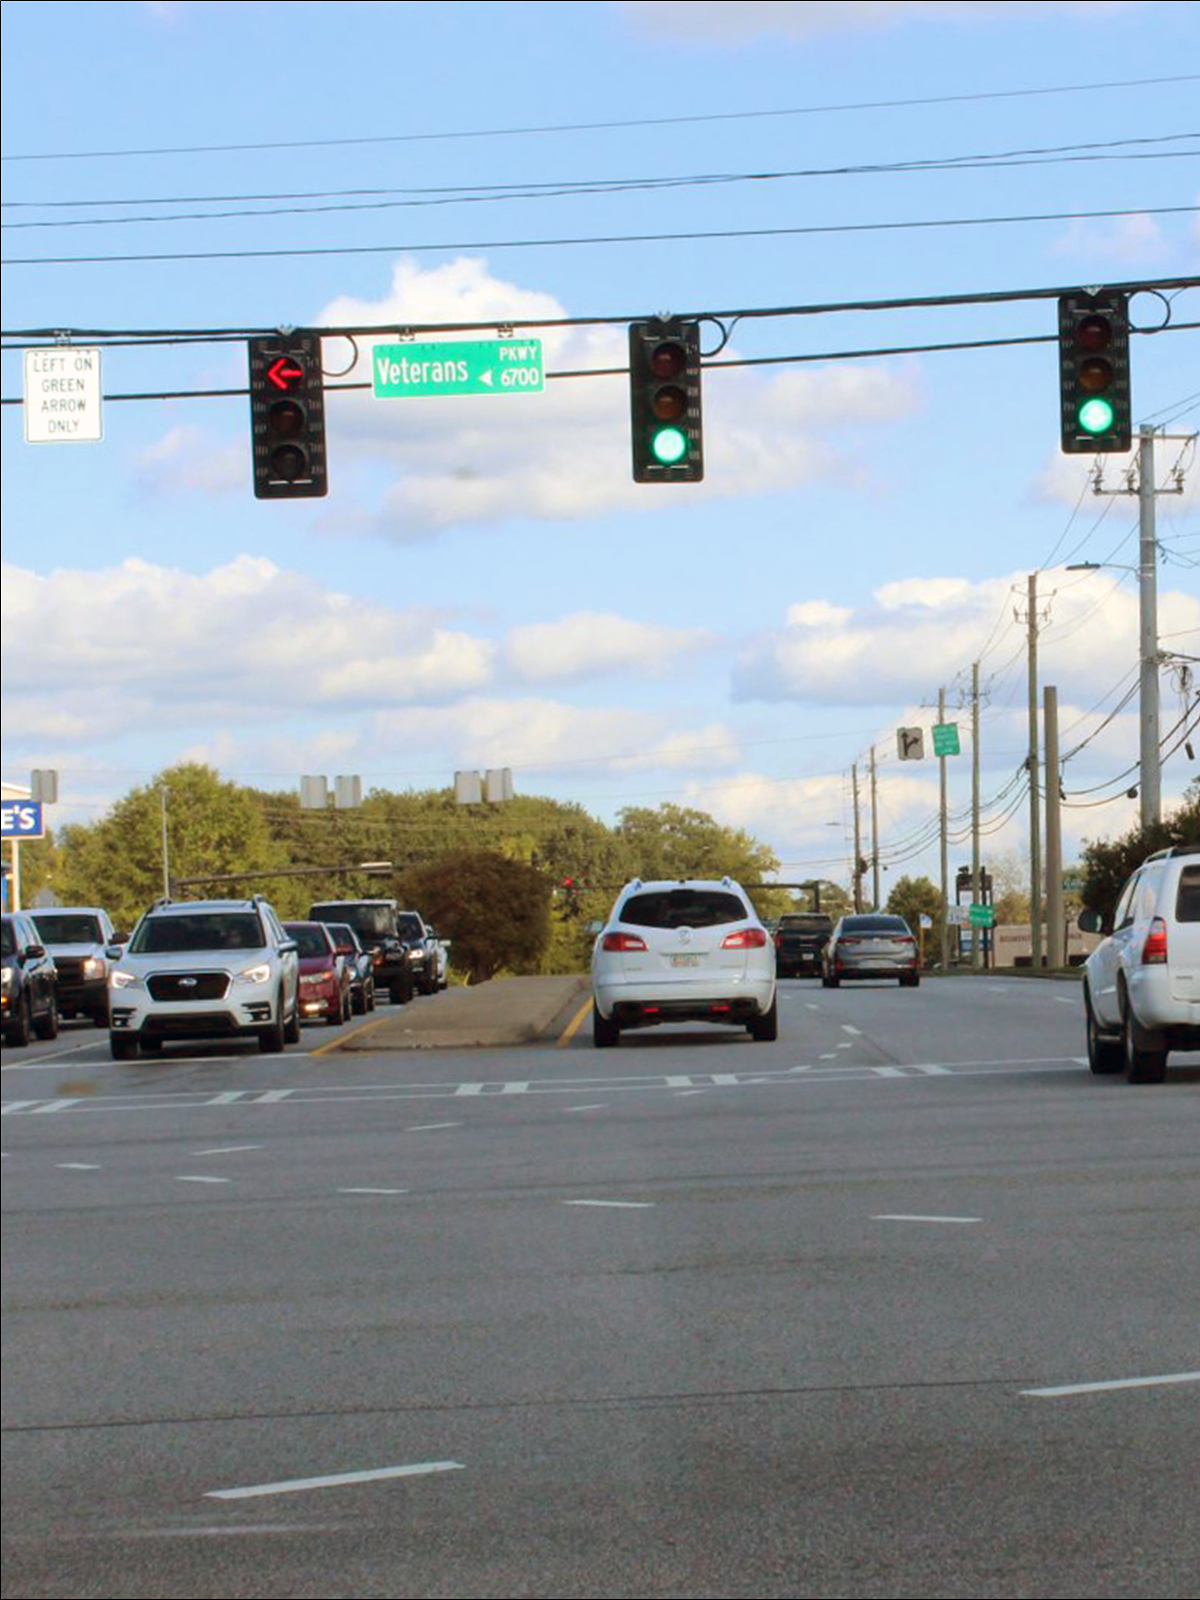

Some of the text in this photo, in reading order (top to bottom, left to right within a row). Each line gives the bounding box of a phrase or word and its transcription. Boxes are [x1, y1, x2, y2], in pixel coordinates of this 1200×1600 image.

[499, 346, 537, 361] PKWY
[33, 357, 93, 373] LEFT ON
[377, 357, 469, 385] Veterans
[500, 367, 539, 387] 6700
[41, 378, 85, 393] GREEN
[41, 398, 86, 413] ARROW
[48, 419, 80, 434] ONLY
[1, 805, 35, 830] E'S
